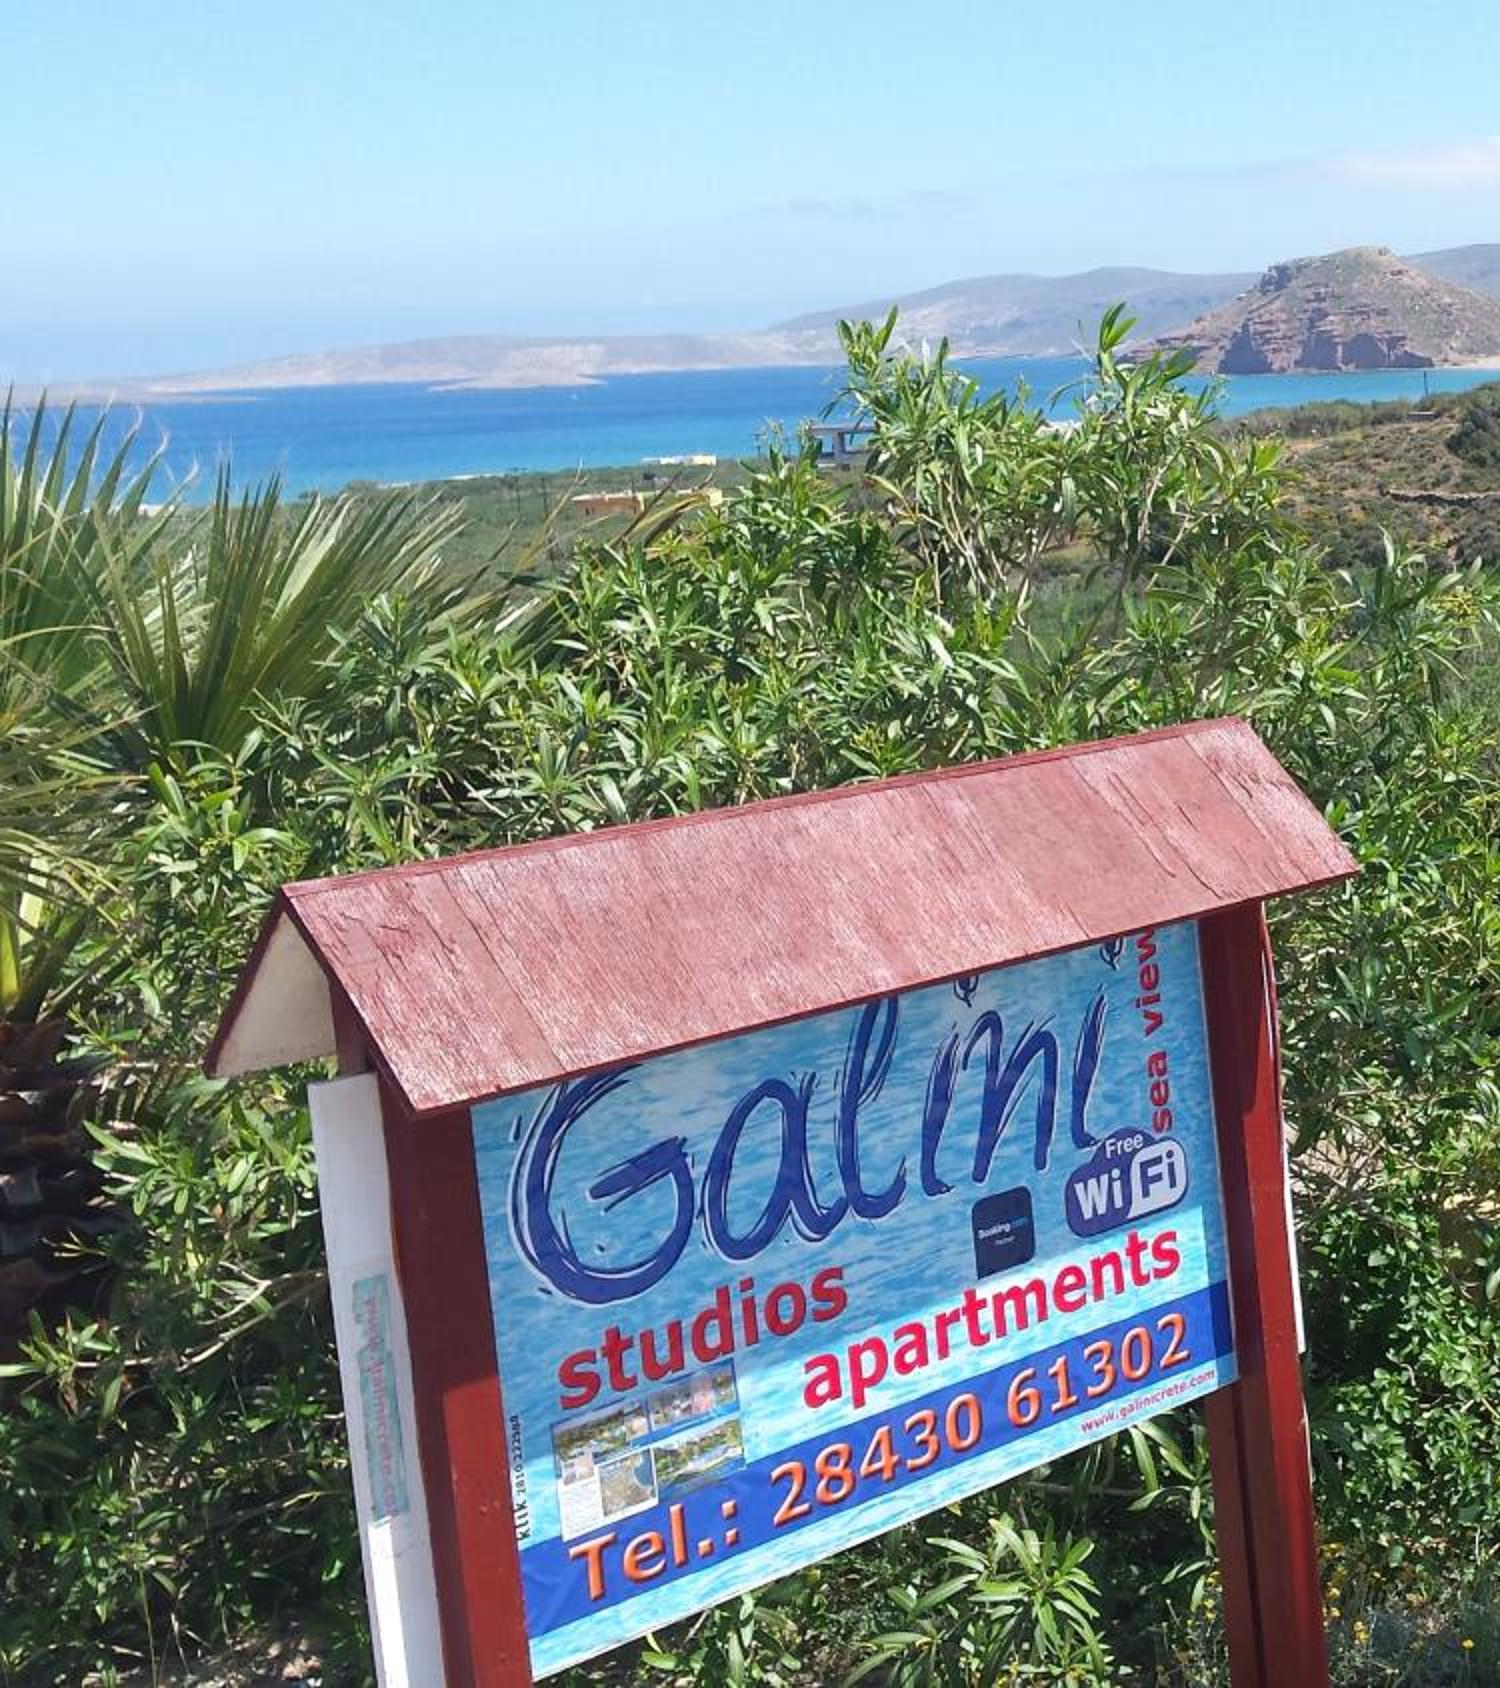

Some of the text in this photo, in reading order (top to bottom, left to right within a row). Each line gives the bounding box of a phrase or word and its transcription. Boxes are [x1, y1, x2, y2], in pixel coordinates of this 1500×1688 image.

[509, 937, 1123, 1305] Galini
[1136, 929, 1174, 1134] sea view
[1105, 1132, 1144, 1160] Free
[558, 1265, 849, 1409] studios
[801, 1230, 1182, 1409] apartments
[1081, 1369, 1216, 1432] www.galinicrete.com
[569, 1312, 1190, 1601] Tel.: 28430 61302
